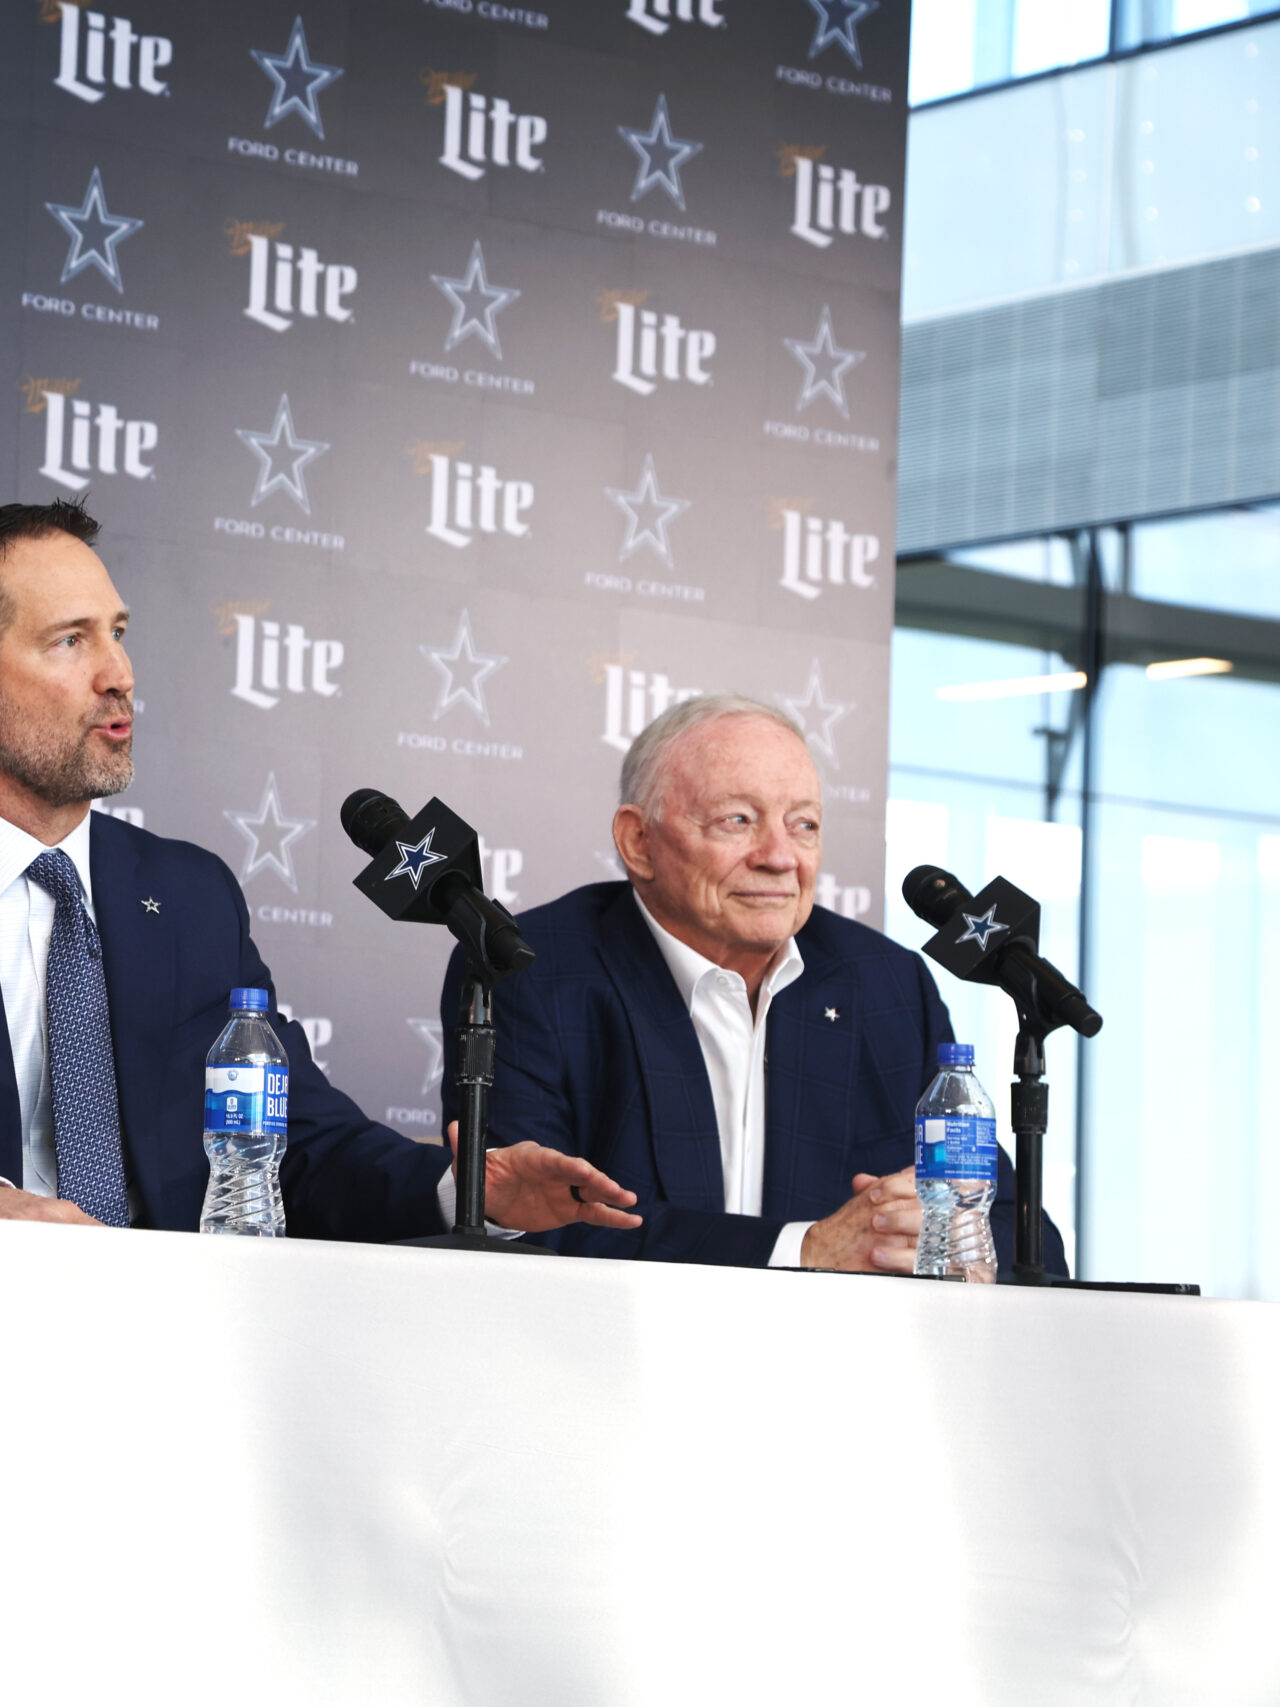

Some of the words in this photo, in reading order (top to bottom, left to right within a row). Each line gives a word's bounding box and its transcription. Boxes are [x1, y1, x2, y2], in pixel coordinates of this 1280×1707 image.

[477, 1, 549, 29] CENTER
[53, 1, 173, 104] Lite
[776, 64, 823, 89] FORD
[826, 75, 892, 102] CENTER
[440, 83, 547, 181] Lite
[228, 136, 278, 162] FORD
[284, 148, 358, 176] CENTER
[790, 155, 891, 248] Lite
[596, 209, 644, 234] FORD
[649, 220, 717, 247] CENTER
[243, 233, 358, 333] Lite
[22, 291, 74, 317] FORD
[82, 303, 159, 331] CENTER
[612, 301, 716, 397] Lite
[410, 359, 458, 383] FORD
[464, 370, 535, 395] CENTER
[38, 390, 158, 491] Lite
[426, 453, 534, 549] Lite
[214, 516, 265, 540] FORD
[271, 527, 345, 551] CENTER
[779, 508, 880, 600] Lite
[585, 570, 632, 595] FORD
[636, 580, 705, 603] CENTER
[231, 613, 344, 710] Lite
[601, 664, 704, 752] Lit
[398, 731, 446, 754] FORD
[451, 741, 524, 762] CENTER
[258, 905, 334, 927] CENTER
[386, 1107, 436, 1126] FORD
